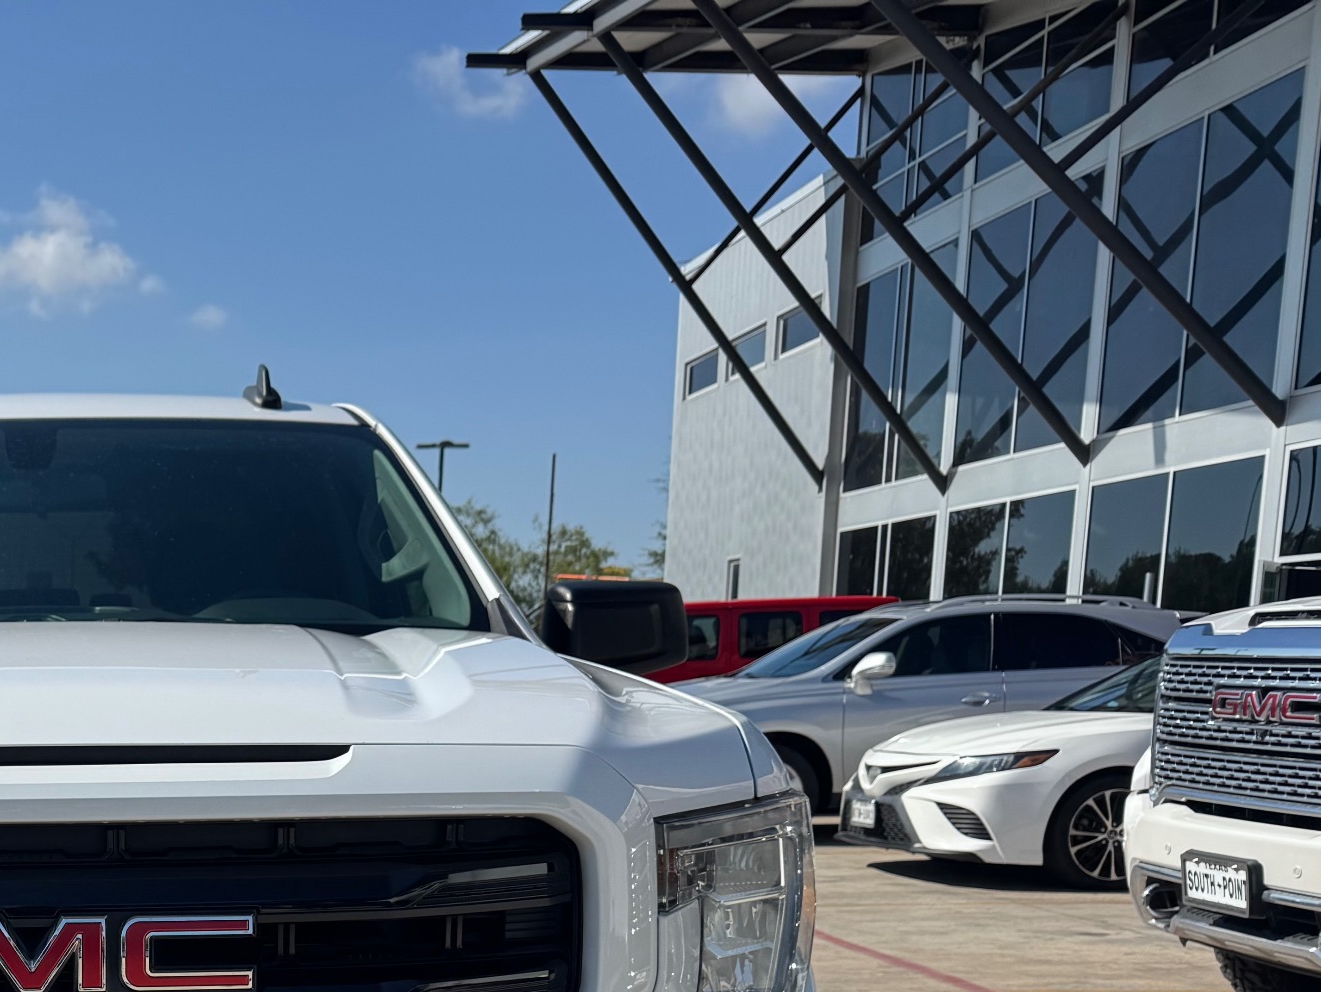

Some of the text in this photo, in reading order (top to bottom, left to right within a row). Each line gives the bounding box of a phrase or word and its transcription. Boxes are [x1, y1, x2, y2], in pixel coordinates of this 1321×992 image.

[1213, 688, 1321, 724] GMC
[1188, 869, 1247, 902] SOUTH POINT
